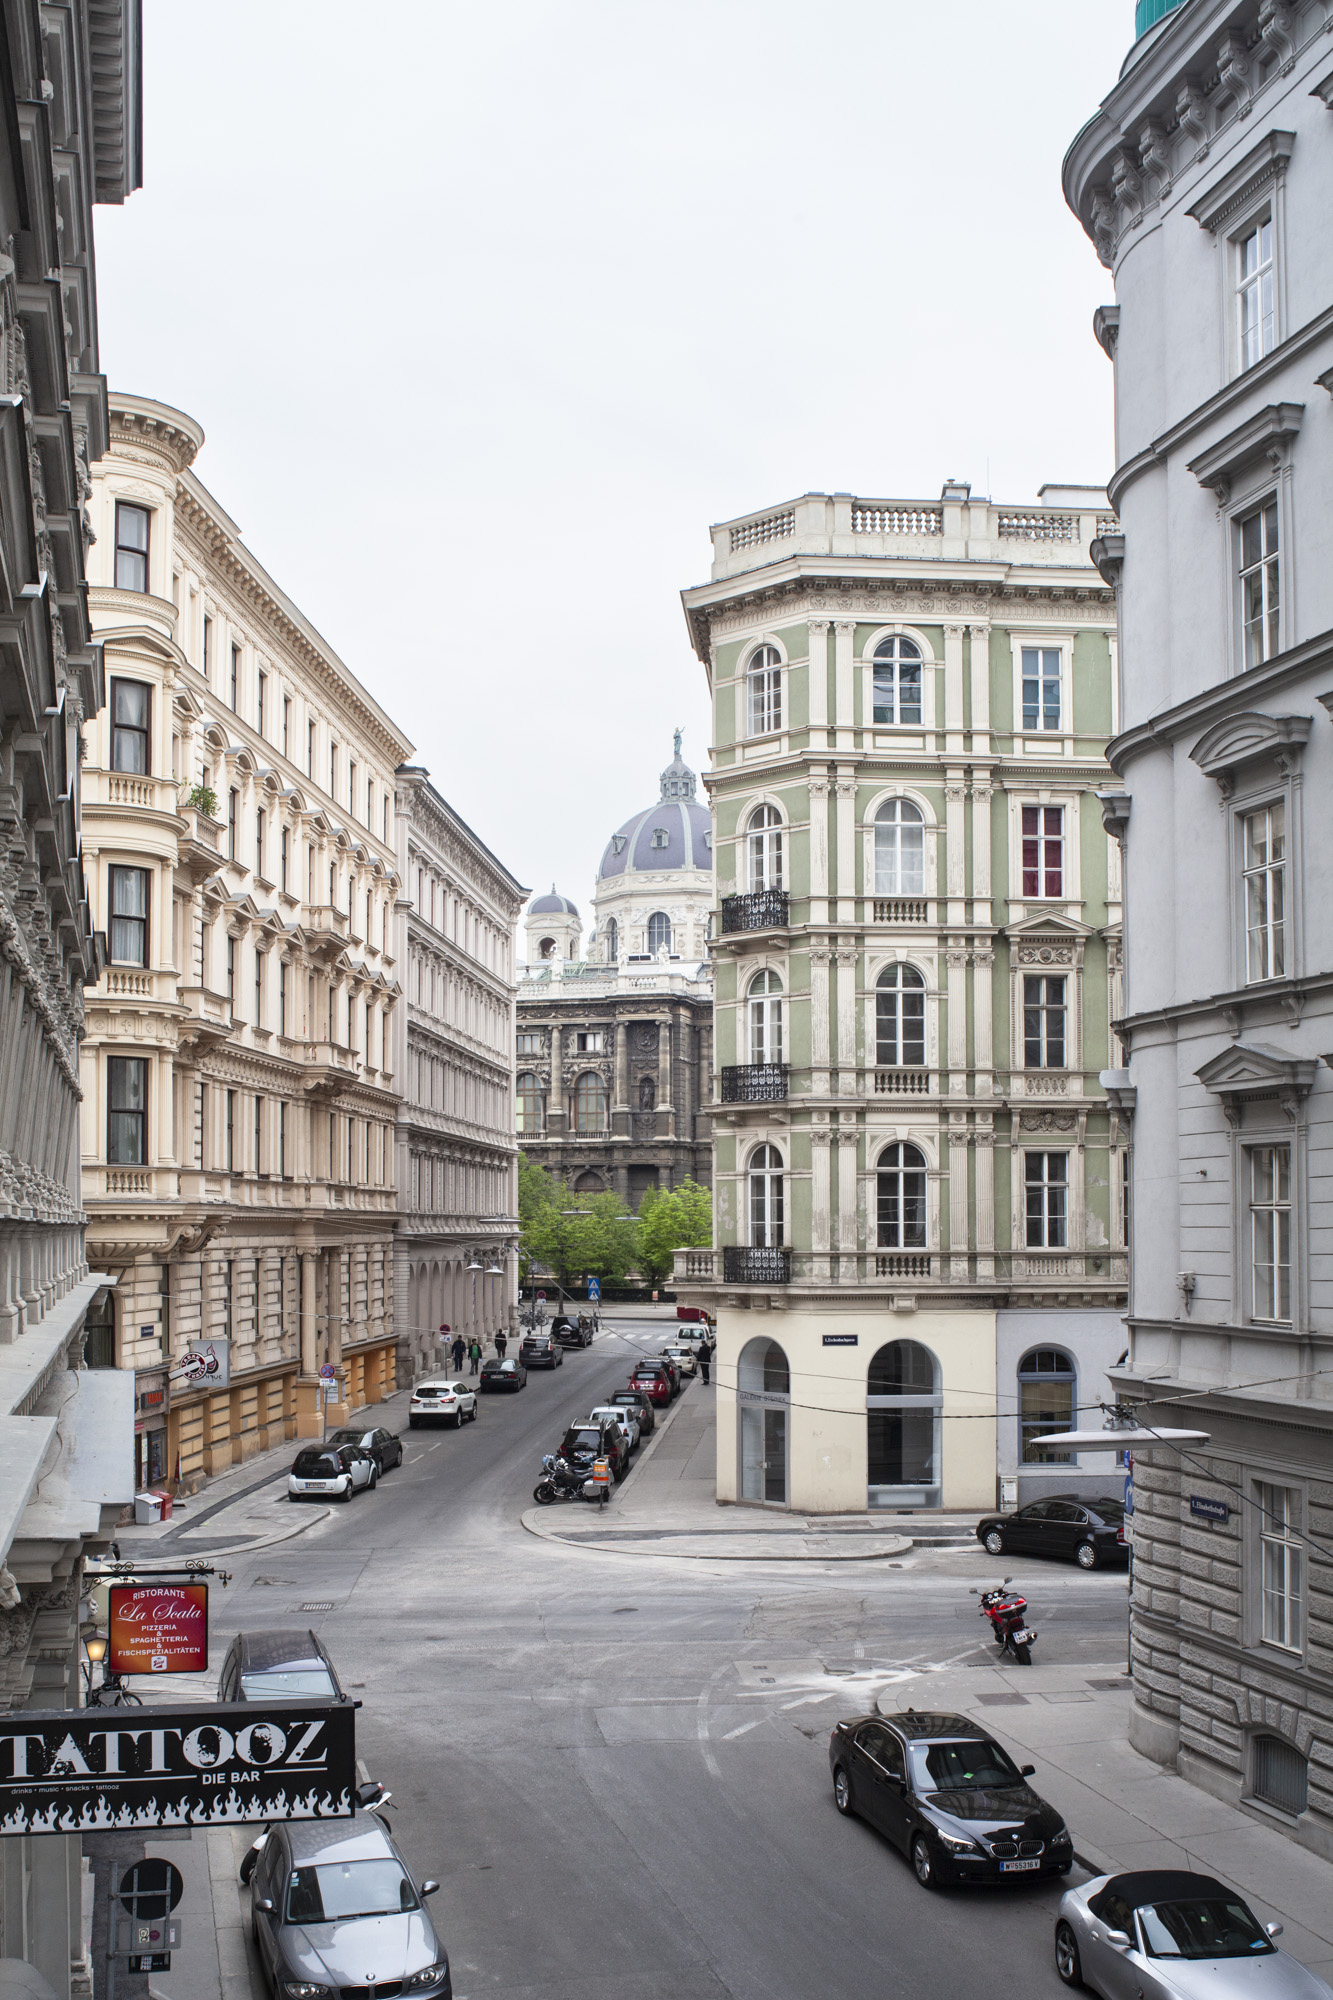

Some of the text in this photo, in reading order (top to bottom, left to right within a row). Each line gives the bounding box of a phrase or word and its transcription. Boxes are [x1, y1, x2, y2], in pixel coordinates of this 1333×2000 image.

[146, 1391, 163, 1405] TABAK
[133, 1588, 186, 1601] RISTORANTE
[115, 1601, 203, 1624] La Scala
[130, 1635, 189, 1644] SPAGHETTERIA
[118, 1647, 201, 1656] FISCHSPEZIALITÄTEN
[0, 1720, 327, 1778] TATTOOZ
[202, 1771, 260, 1785] DIE BAR
